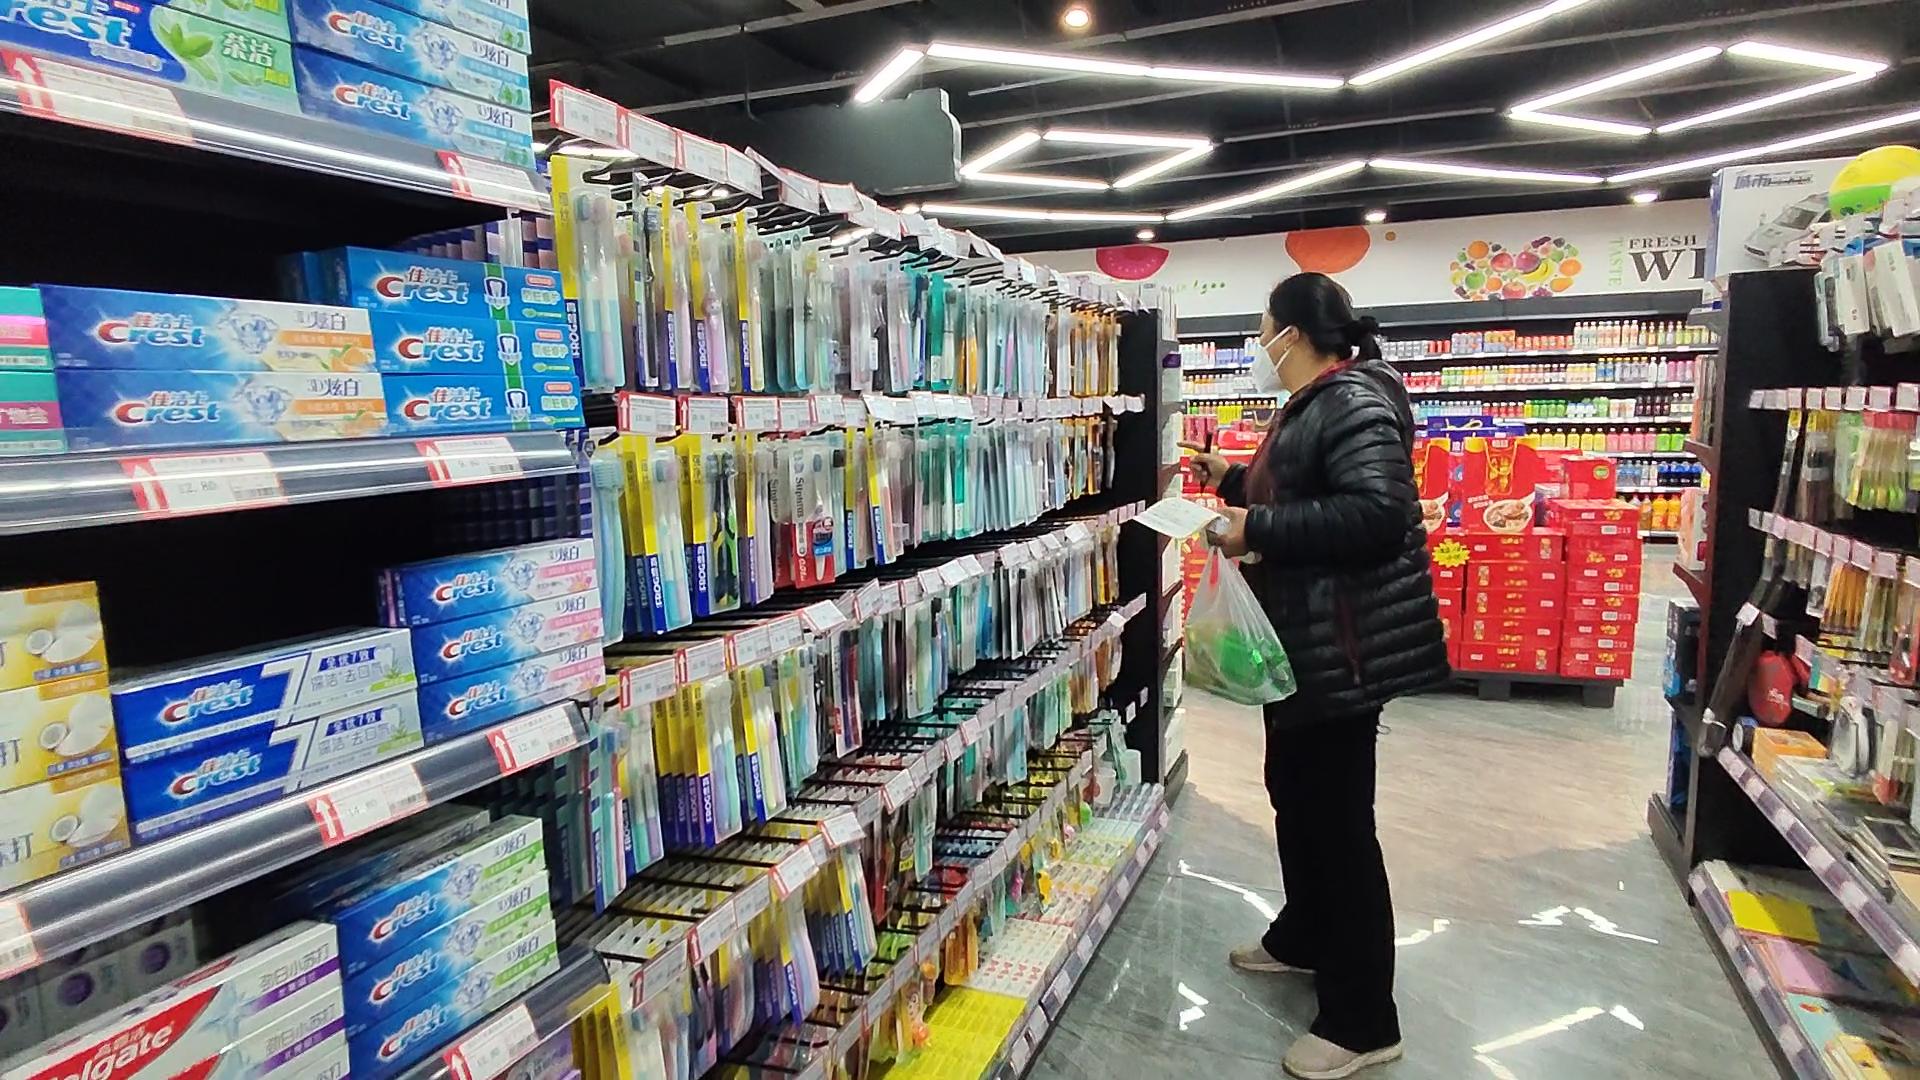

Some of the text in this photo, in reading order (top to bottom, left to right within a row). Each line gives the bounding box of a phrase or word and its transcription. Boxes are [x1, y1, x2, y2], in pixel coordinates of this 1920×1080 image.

[0, 0, 132, 49] rest
[328, 13, 405, 52] Crest
[334, 85, 410, 120] Crest
[1629, 234, 1697, 249] FRESH
[1608, 238, 1624, 287] TASTE
[376, 274, 469, 304] Crest
[97, 320, 206, 347] Crest
[397, 337, 485, 362] Crest
[114, 400, 221, 424] Crest
[403, 396, 492, 420] Crest
[435, 577, 496, 602] Crest
[442, 632, 503, 660] Crest
[162, 684, 256, 723] Crest
[448, 686, 507, 717] Crest
[170, 752, 263, 796] Crest
[373, 894, 438, 941] Crest
[372, 951, 440, 1002] Crest
[380, 1006, 449, 1058] Crest
